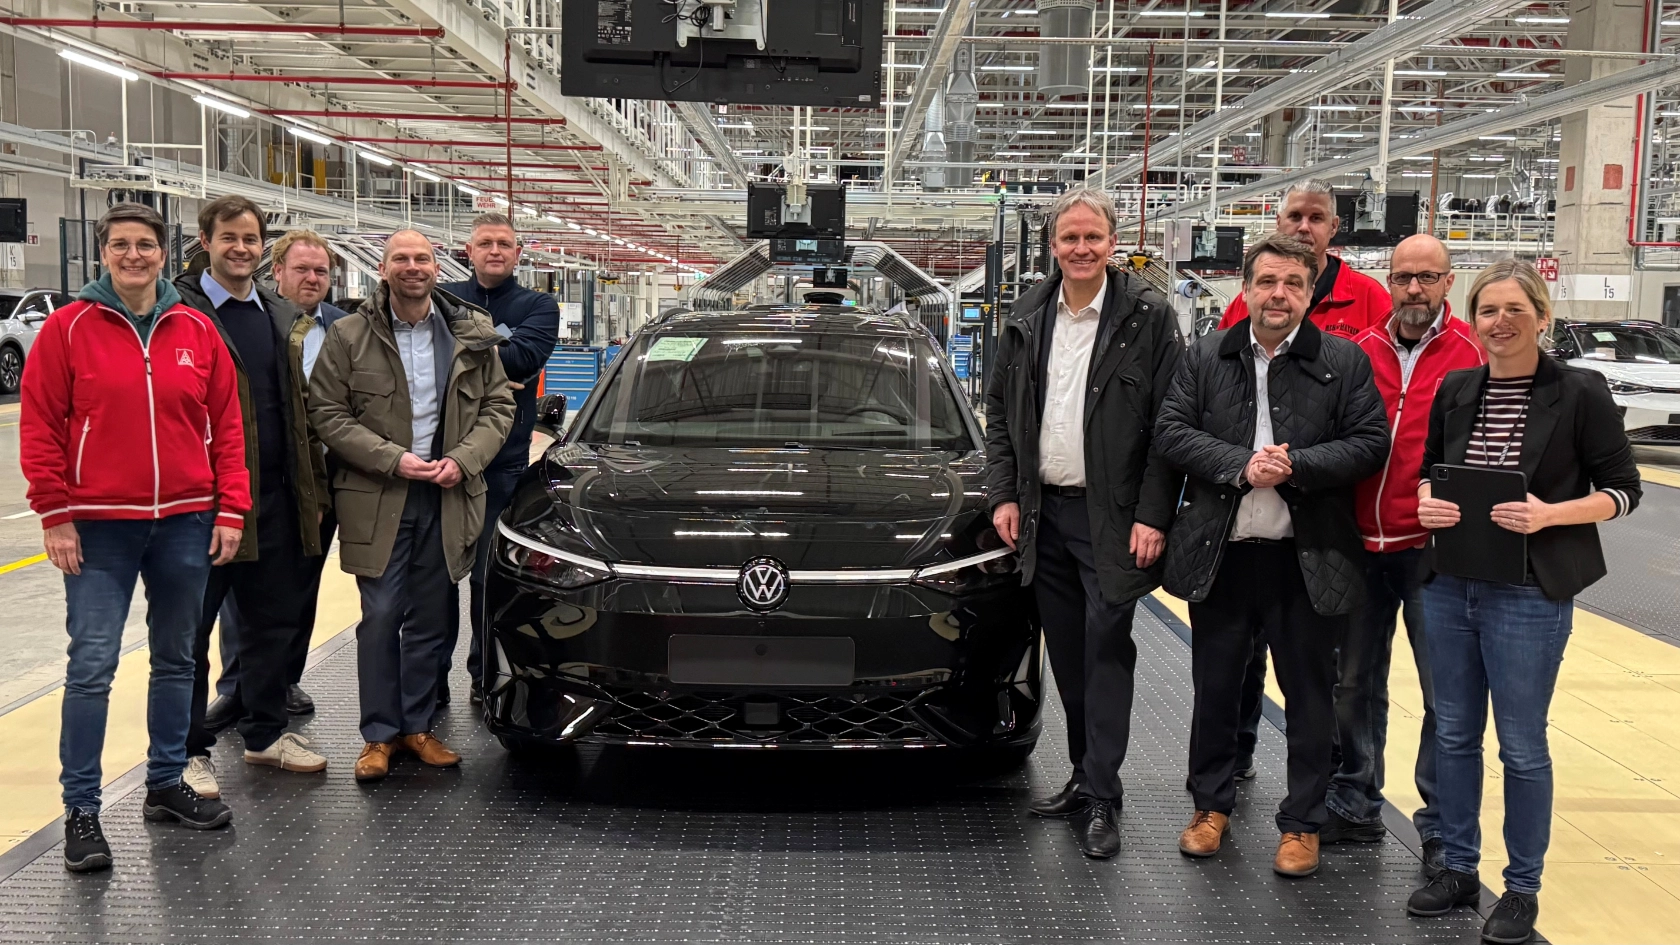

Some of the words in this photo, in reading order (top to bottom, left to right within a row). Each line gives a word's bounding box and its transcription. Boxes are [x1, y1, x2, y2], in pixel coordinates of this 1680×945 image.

[10, 256, 17, 267] 15
[1604, 277, 1611, 288] L
[1561, 287, 1567, 299] 15
[1604, 288, 1615, 299] 15
[743, 565, 784, 604] VW
